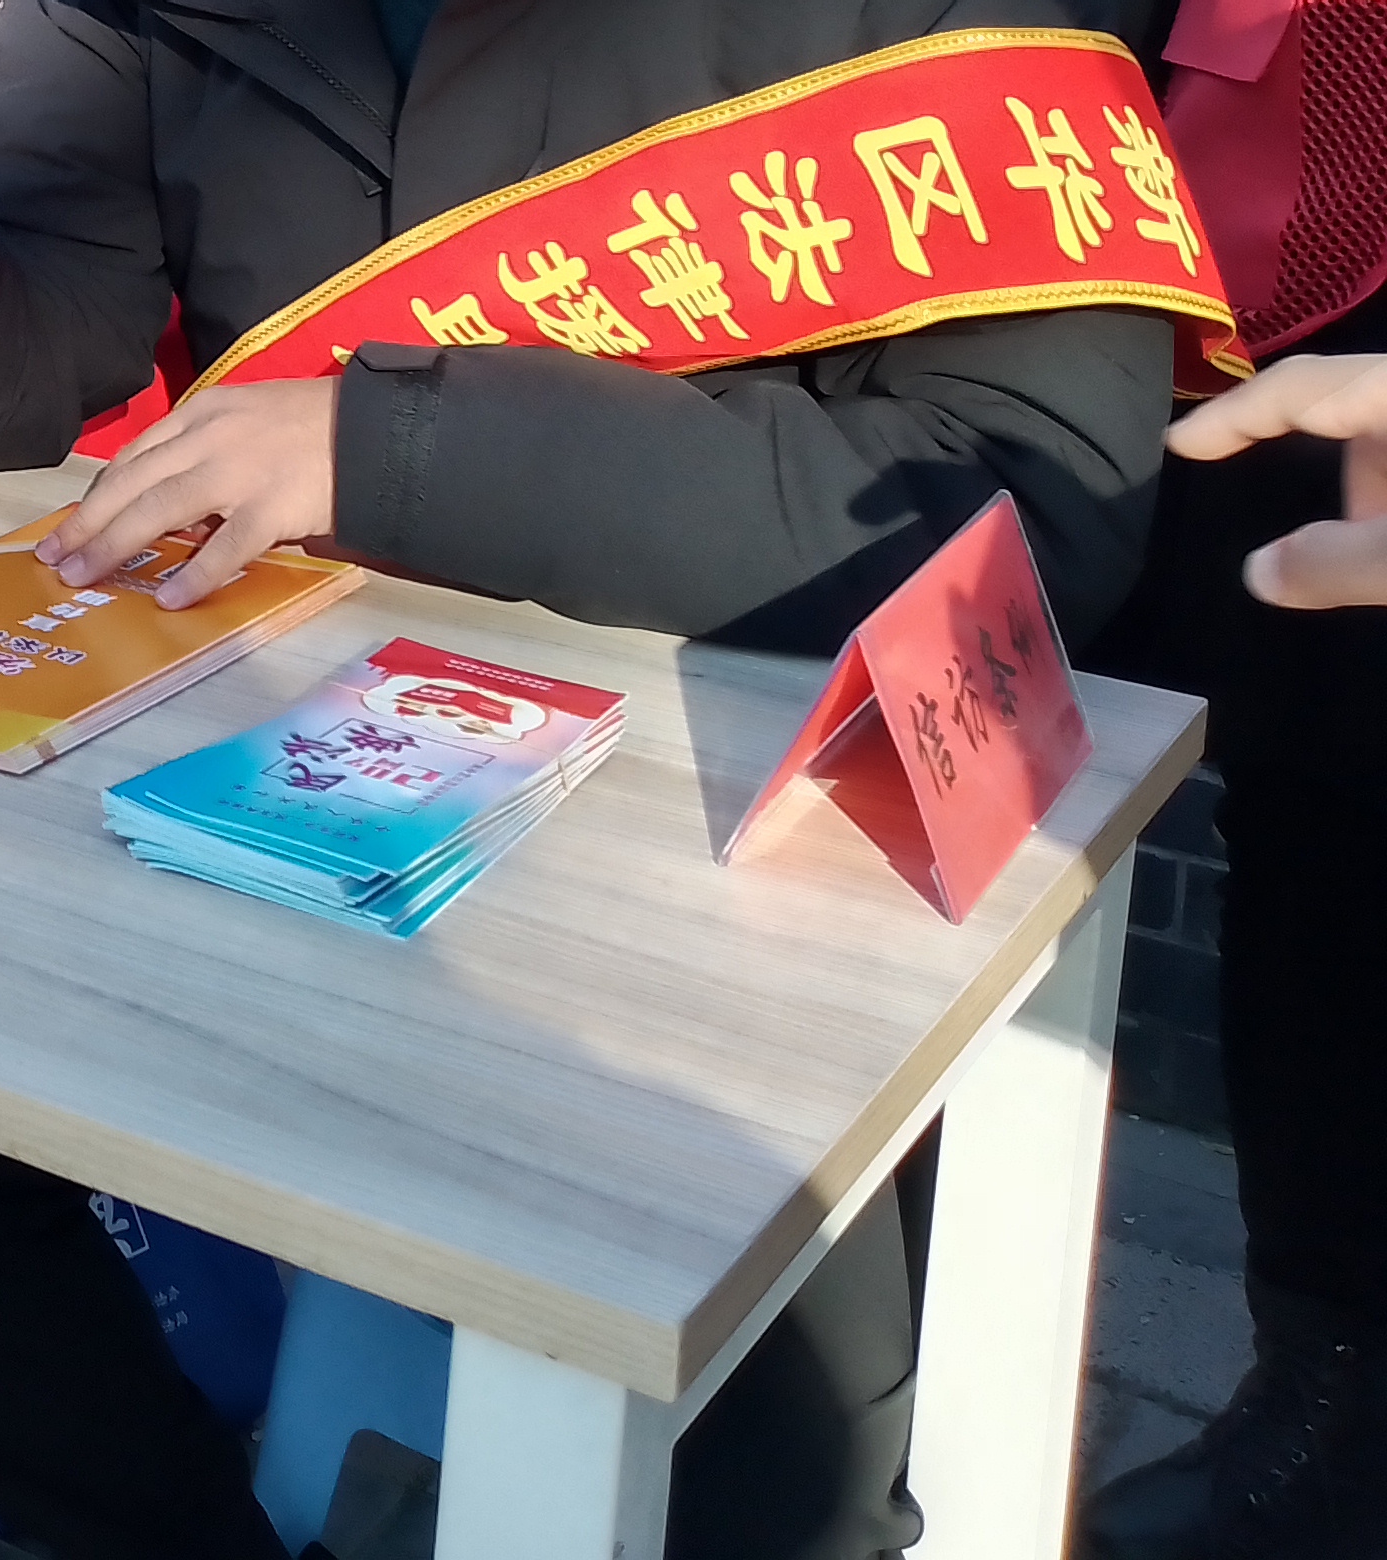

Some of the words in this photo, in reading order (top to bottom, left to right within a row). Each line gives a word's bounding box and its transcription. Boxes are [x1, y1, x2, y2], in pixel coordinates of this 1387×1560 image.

[330, 95, 1199, 366] 新华区法律援
